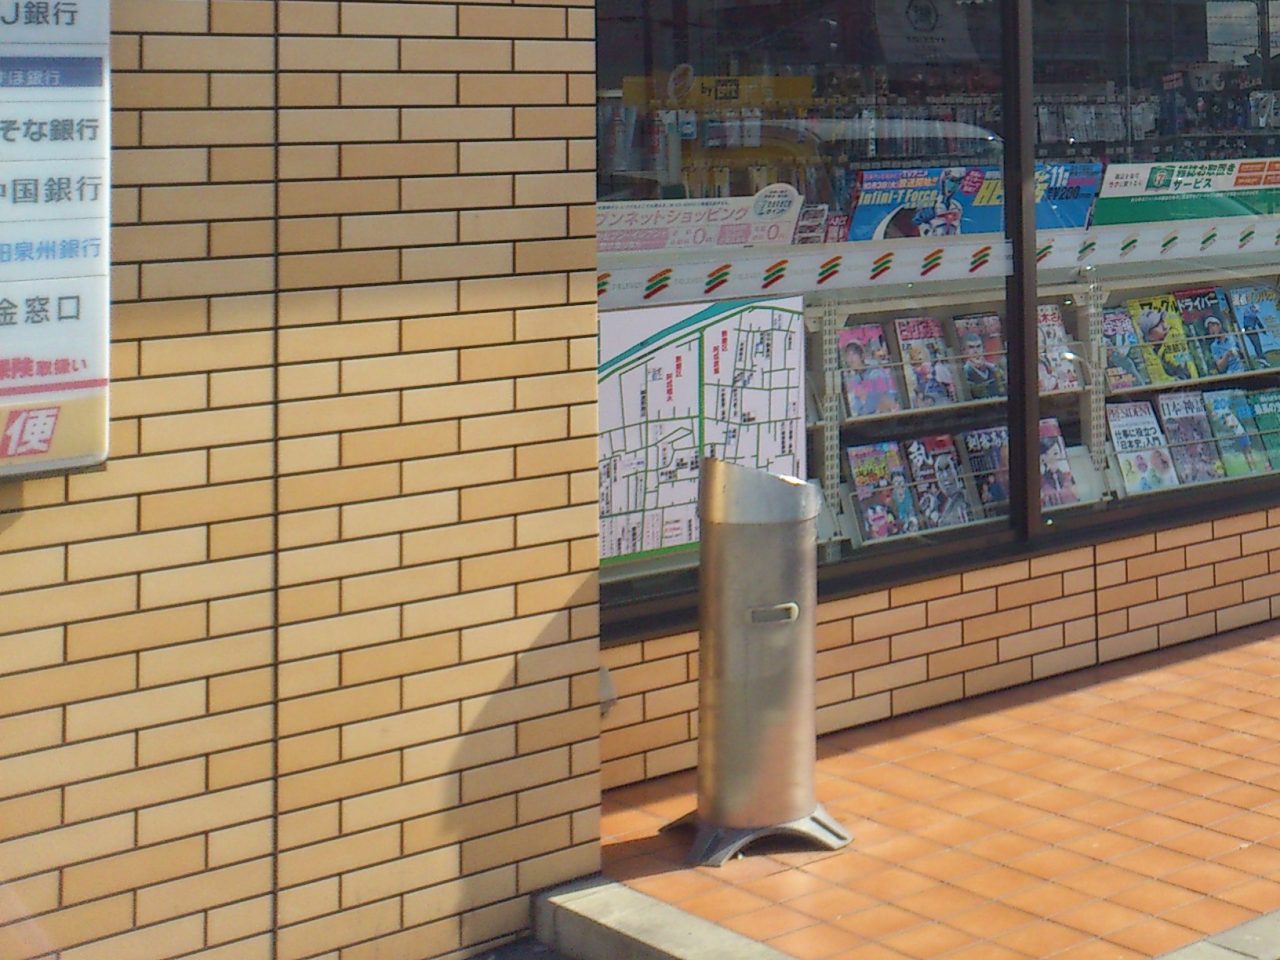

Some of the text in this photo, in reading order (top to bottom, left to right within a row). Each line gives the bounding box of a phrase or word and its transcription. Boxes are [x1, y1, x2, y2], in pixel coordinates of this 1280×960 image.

[0, 175, 102, 204] 国銀行
[1177, 296, 1218, 313] ドライバー
